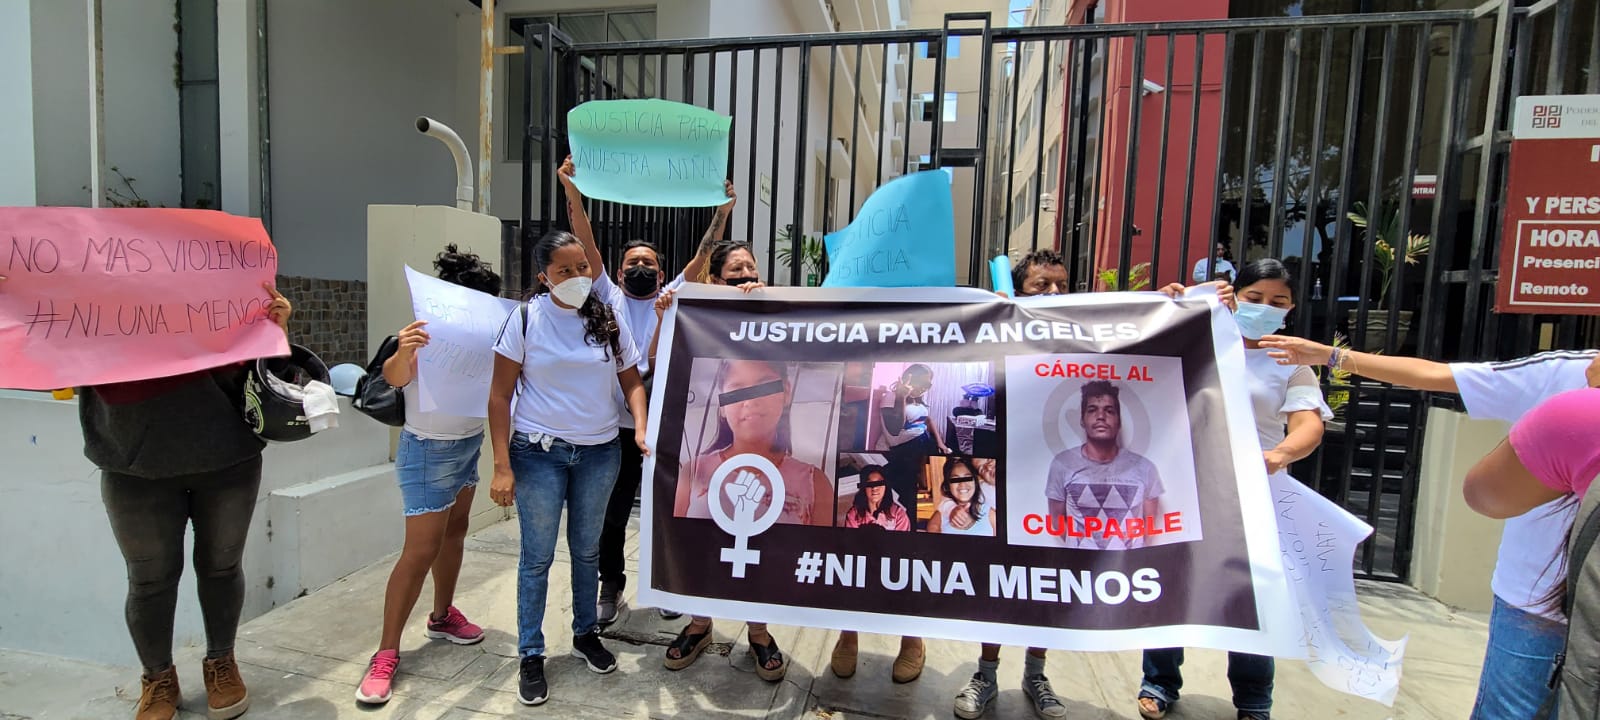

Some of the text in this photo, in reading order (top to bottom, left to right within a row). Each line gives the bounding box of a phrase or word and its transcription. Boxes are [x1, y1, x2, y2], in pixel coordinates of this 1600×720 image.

[579, 108, 722, 142] JUSTICIA PARA
[578, 146, 722, 182] NUESTRA NIÑA
[1526, 197, 1541, 214] Y
[9, 236, 276, 274] NO MAS VIOLENCIA
[1520, 282, 1588, 296] Remoto
[729, 319, 1139, 343] JUSTICIA PARA ANGELES
[1034, 359, 1153, 382] CÁRCEL AL
[1022, 511, 1183, 540] CULPABLE
[795, 551, 1162, 606] #NI UNA MENOS
